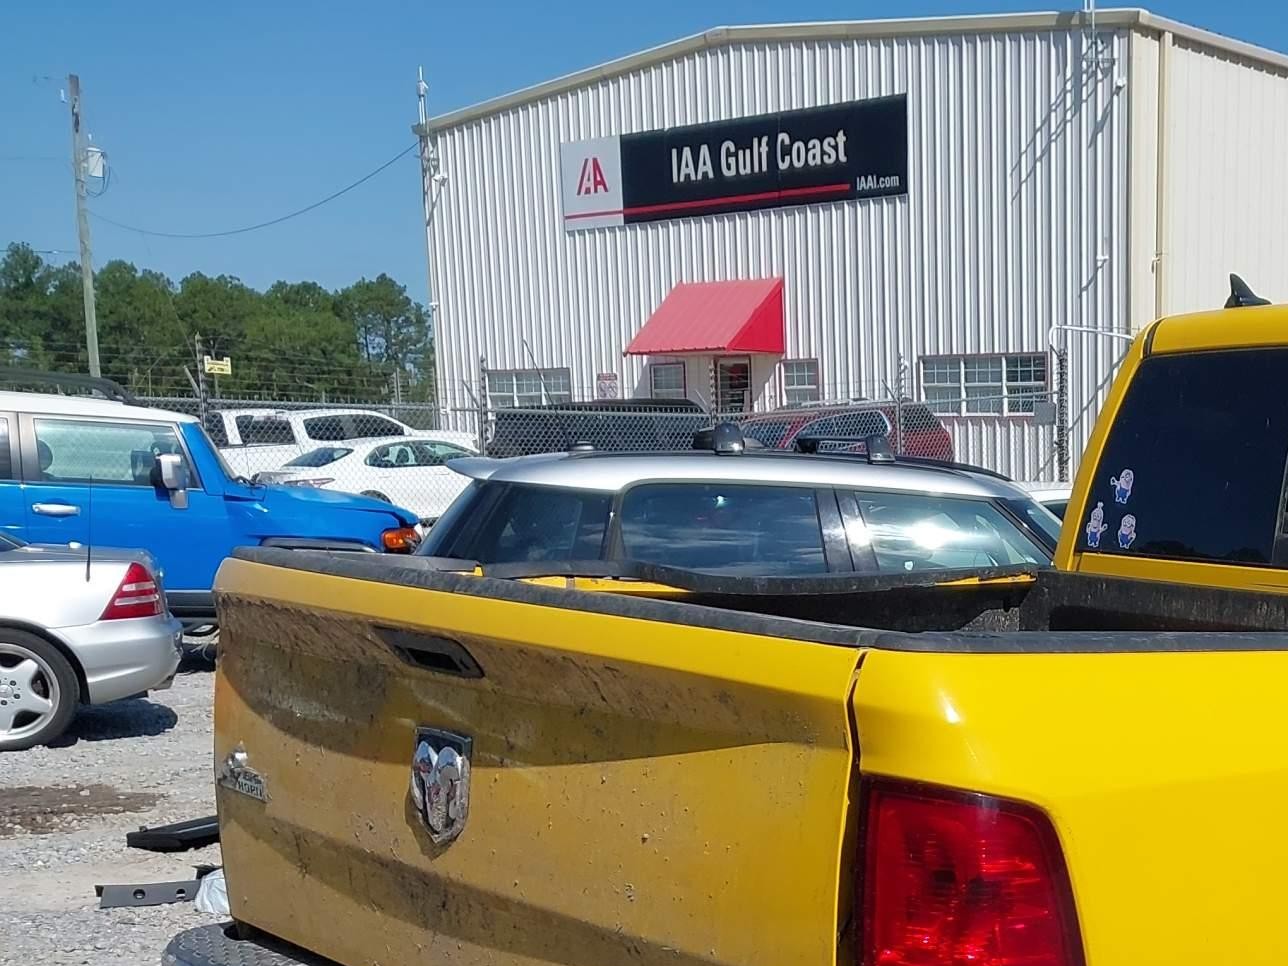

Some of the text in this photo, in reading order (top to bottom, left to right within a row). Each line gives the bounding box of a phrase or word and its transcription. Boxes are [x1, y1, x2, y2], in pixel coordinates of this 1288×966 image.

[671, 129, 848, 183] IAA Gulf Coast
